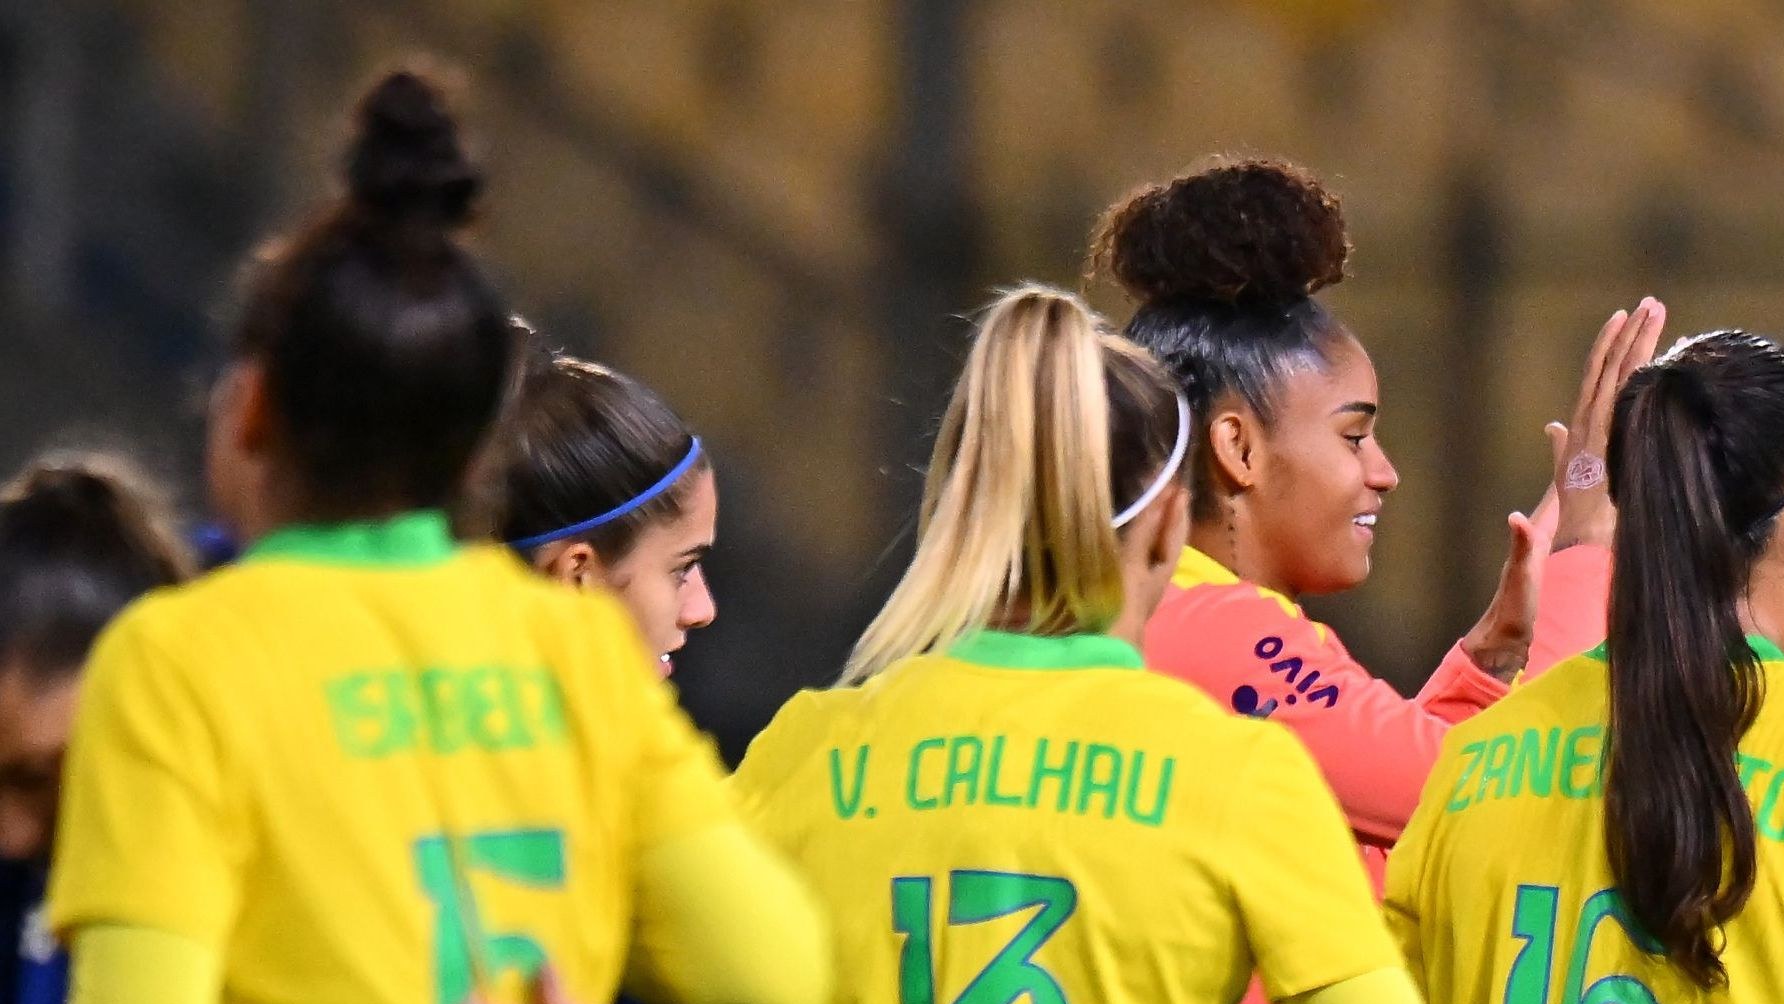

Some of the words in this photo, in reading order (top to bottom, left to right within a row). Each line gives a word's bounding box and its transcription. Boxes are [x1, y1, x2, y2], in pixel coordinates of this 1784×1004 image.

[1254, 636, 1339, 708] vivo
[829, 744, 877, 820] V.
[905, 735, 1175, 827] CALHAU
